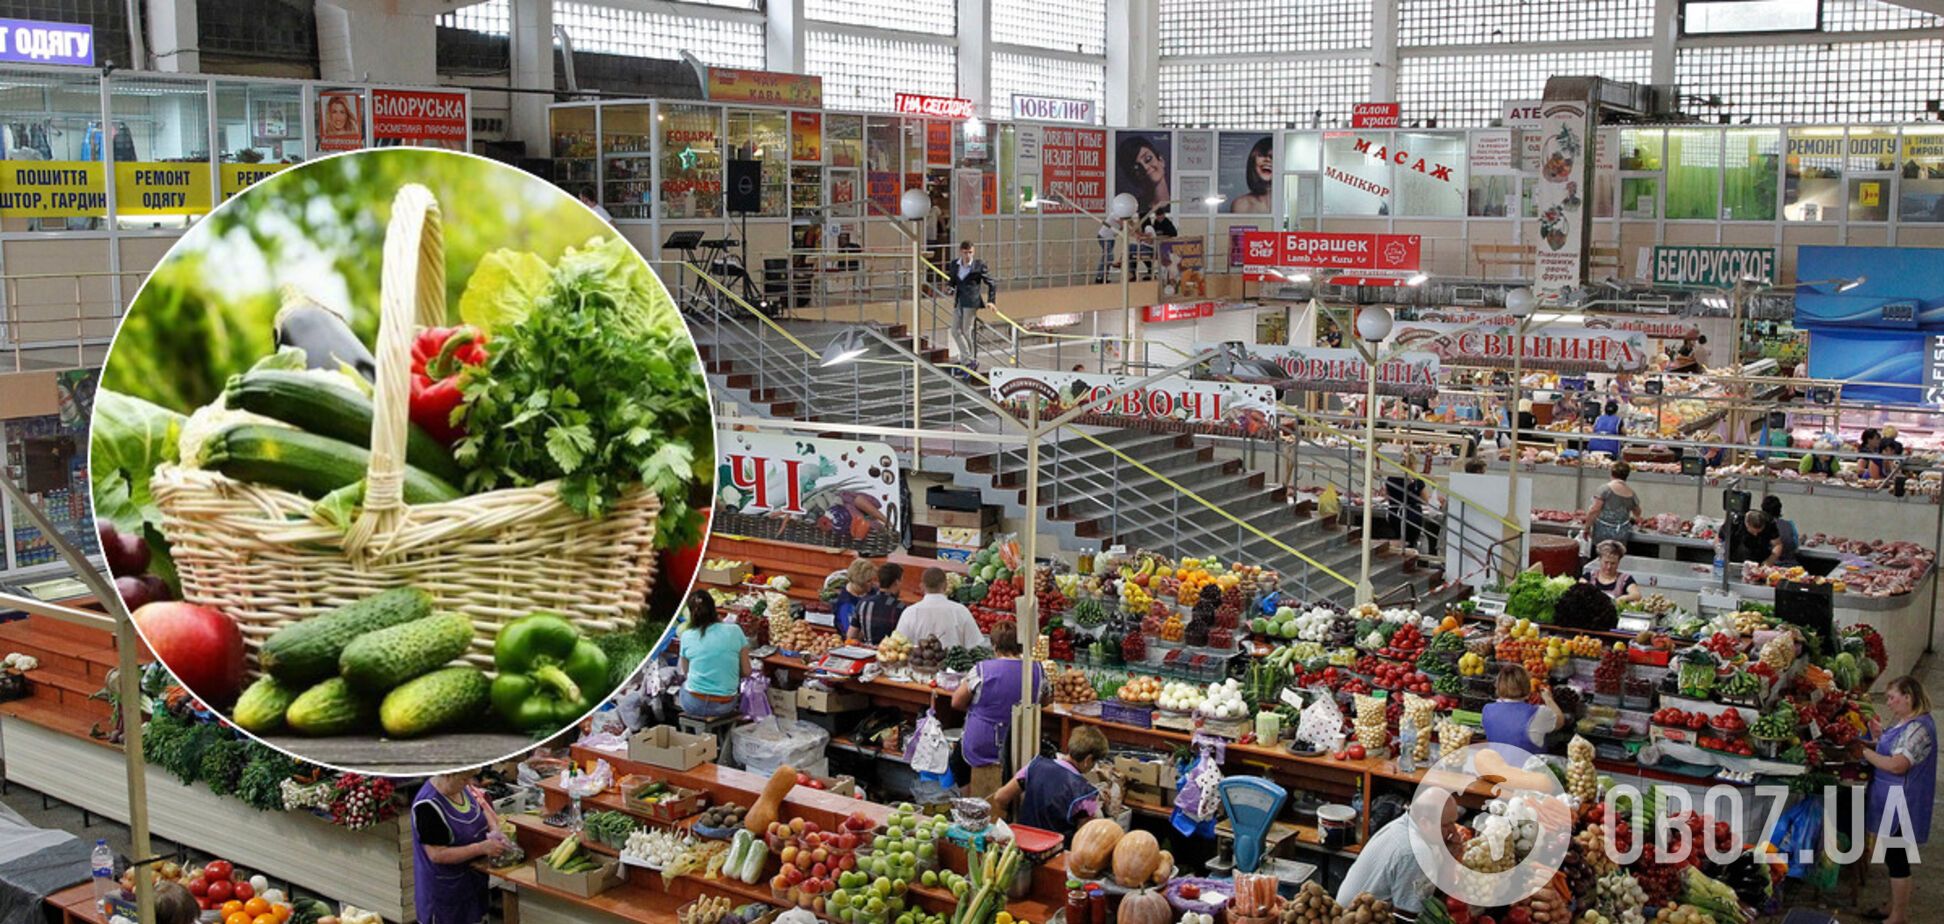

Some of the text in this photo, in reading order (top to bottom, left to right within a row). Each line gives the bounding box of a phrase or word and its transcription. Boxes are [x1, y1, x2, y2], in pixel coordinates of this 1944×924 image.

[15, 27, 90, 60] ОДЯГУ
[749, 88, 781, 101] КАВА
[374, 95, 464, 119] БІЛОРУСЬКА
[1021, 98, 1089, 120] ЮВЕЛИР
[1353, 103, 1390, 115] Салон
[1362, 116, 1398, 128] краси
[1788, 139, 1842, 155] РЕМОНТ
[1850, 138, 1896, 155] ОДЯГУ
[1353, 138, 1454, 182] МАСАЖ
[16, 170, 87, 187] ПОШИТТЯ
[136, 170, 190, 187] РЕМОНТ
[1324, 166, 1390, 197] МАНІКЮР
[1050, 181, 1100, 196] РЕМОНТ
[0, 191, 106, 211] ШТОР, ГАРДИН
[143, 192, 185, 210] ОДЯГУ
[1249, 248, 1275, 257] CHEF
[1286, 235, 1368, 255] Барашек
[1287, 254, 1311, 263] Lamb
[1657, 249, 1772, 283] БЕЛОРУССКОЕ
[1458, 332, 1633, 362] СВИНИНА
[1090, 385, 1223, 421] ОВОЧІ
[728, 454, 806, 514] ЧІ
